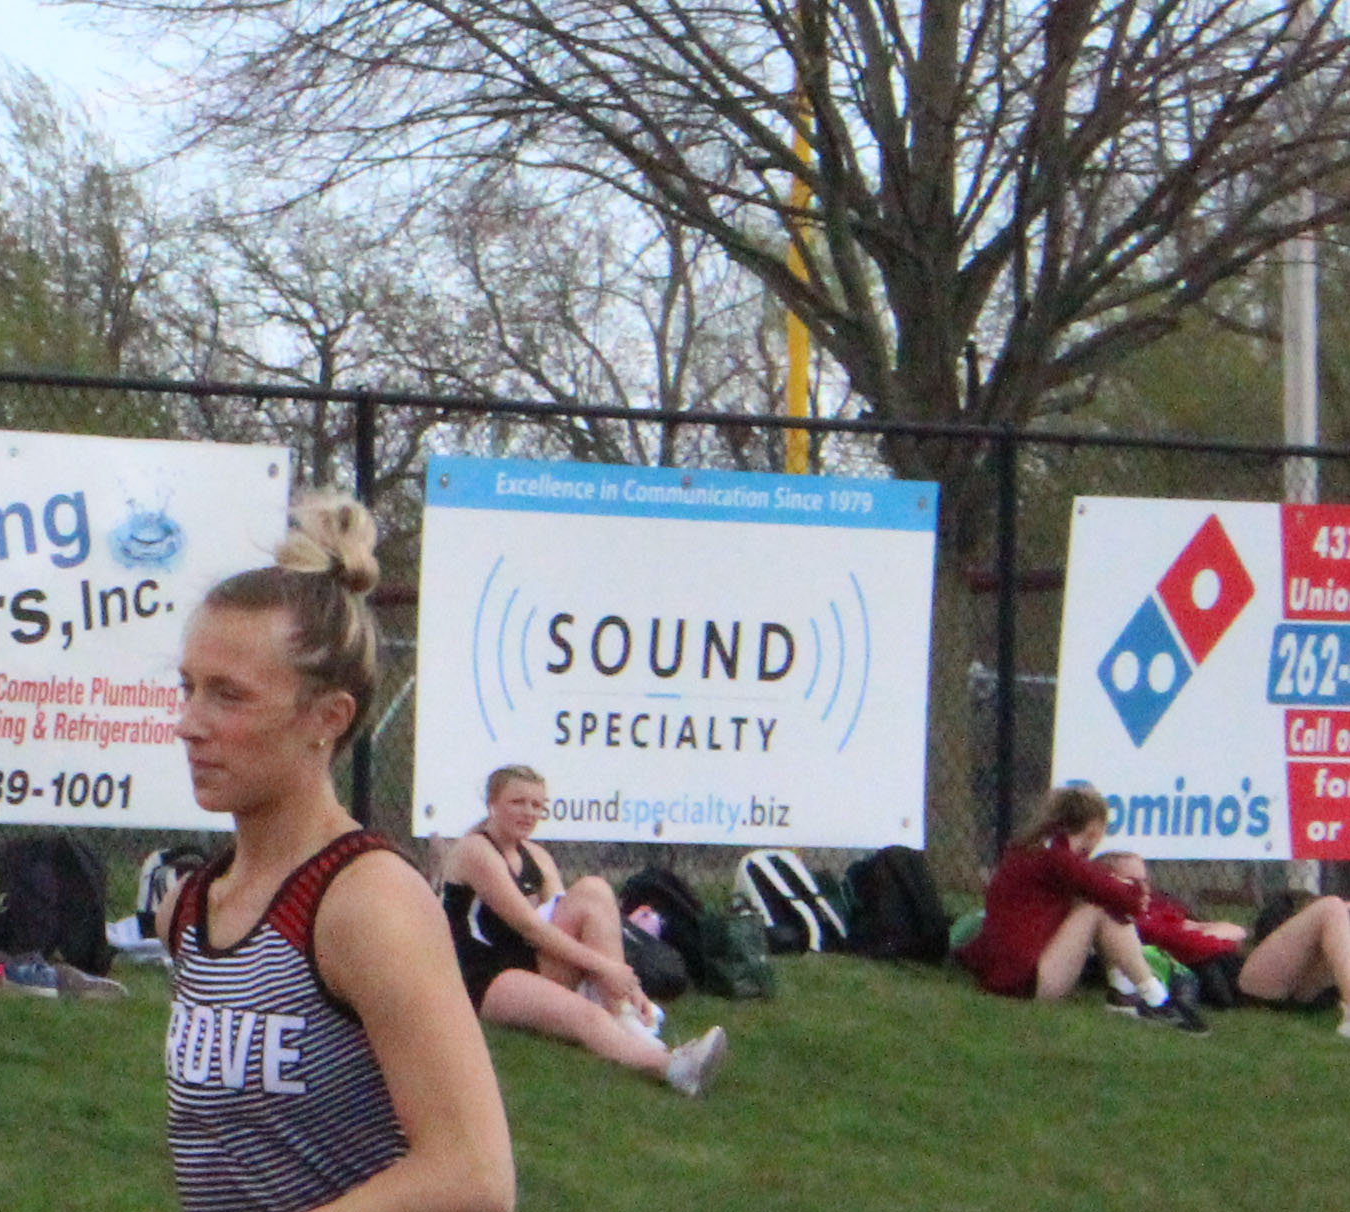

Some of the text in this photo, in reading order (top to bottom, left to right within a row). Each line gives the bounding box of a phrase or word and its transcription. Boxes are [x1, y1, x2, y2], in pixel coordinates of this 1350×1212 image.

[495, 471, 874, 514] Excellence in Communication Since 1979
[1312, 526, 1350, 560] 43
[1288, 577, 1350, 612] Unio
[546, 613, 796, 681] SOUND
[32, 711, 47, 740] &
[54, 712, 176, 750] Refrigeration
[554, 710, 778, 752] SPECIALTY
[1290, 717, 1332, 753] Call
[1314, 767, 1350, 799] fo
[1065, 776, 1271, 838] omino's
[1307, 820, 1343, 842] or
